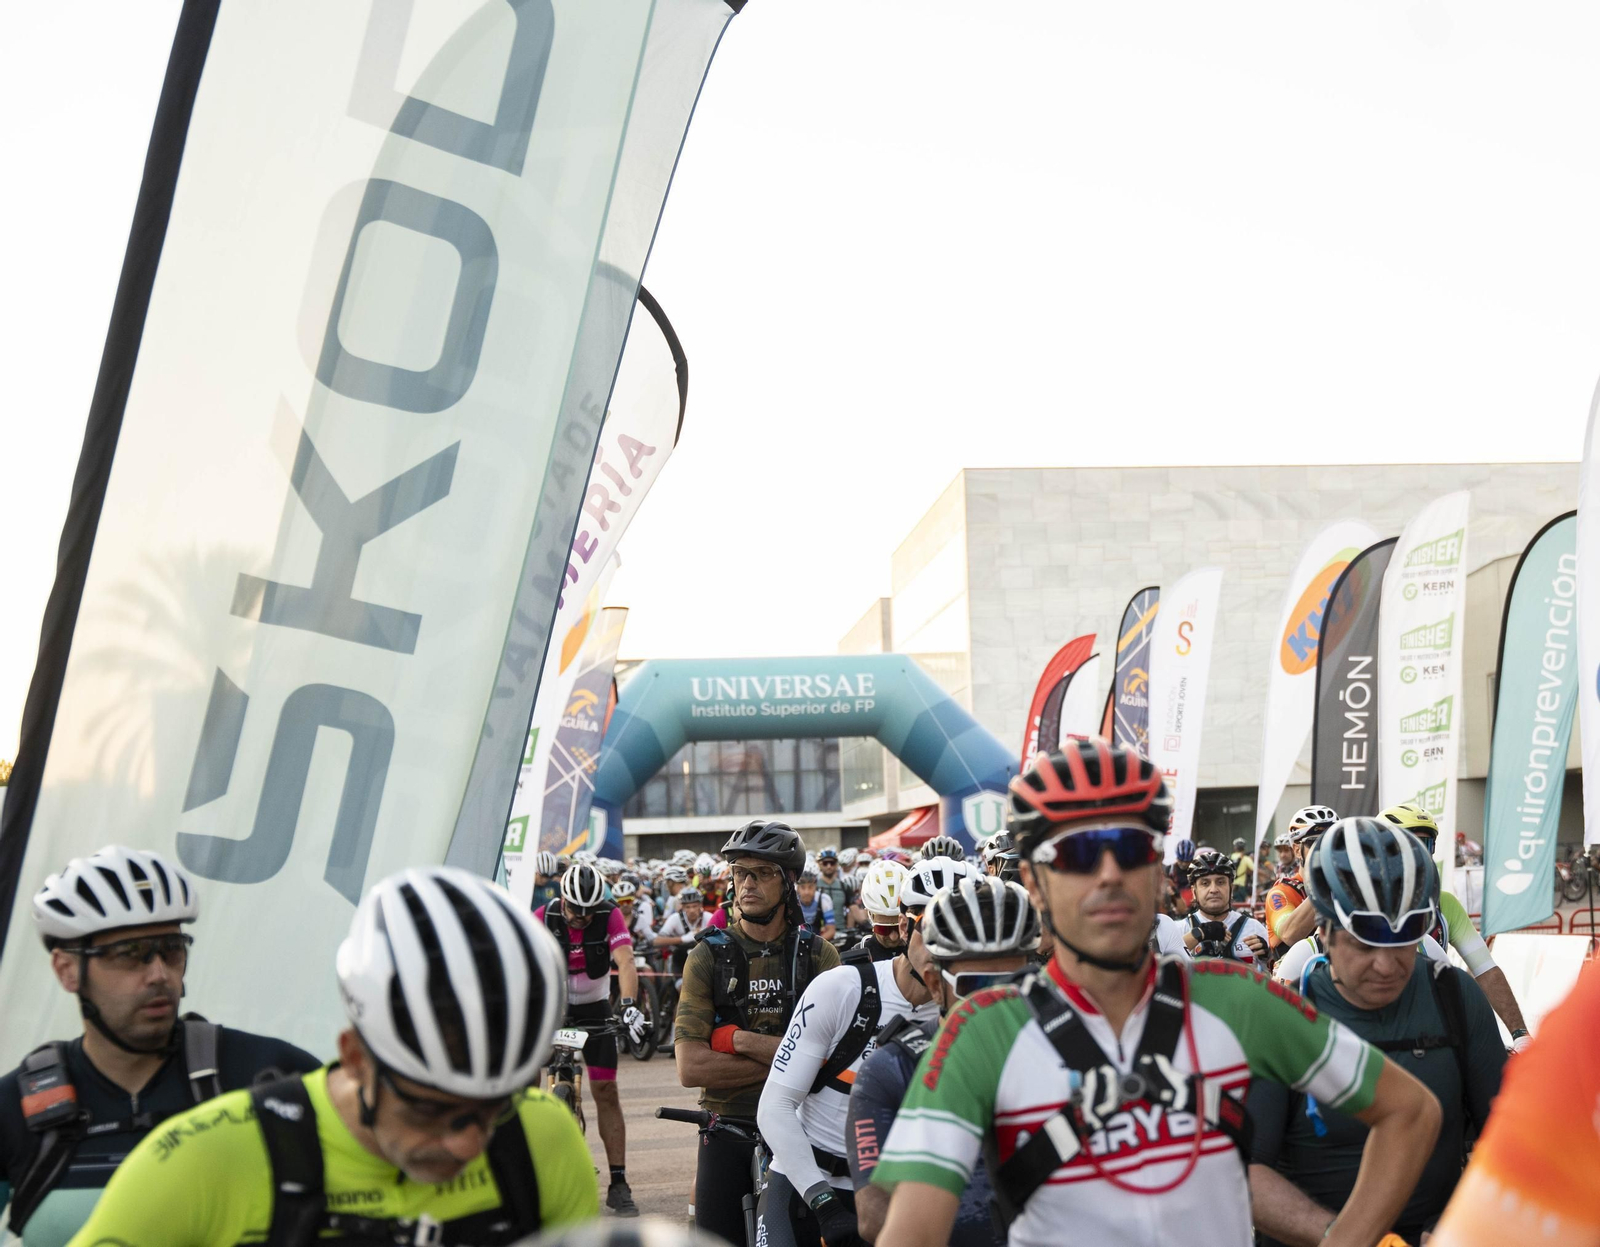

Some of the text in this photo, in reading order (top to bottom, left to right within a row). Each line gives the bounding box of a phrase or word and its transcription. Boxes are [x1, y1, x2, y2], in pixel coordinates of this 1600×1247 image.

[690, 673, 876, 701] UNIVERSAE
[691, 700, 875, 718] Instituto Superior de FP
[1175, 702, 1185, 734] DEPORTE
[559, 1031, 577, 1040] 143
[855, 1119, 879, 1171] VENTI
